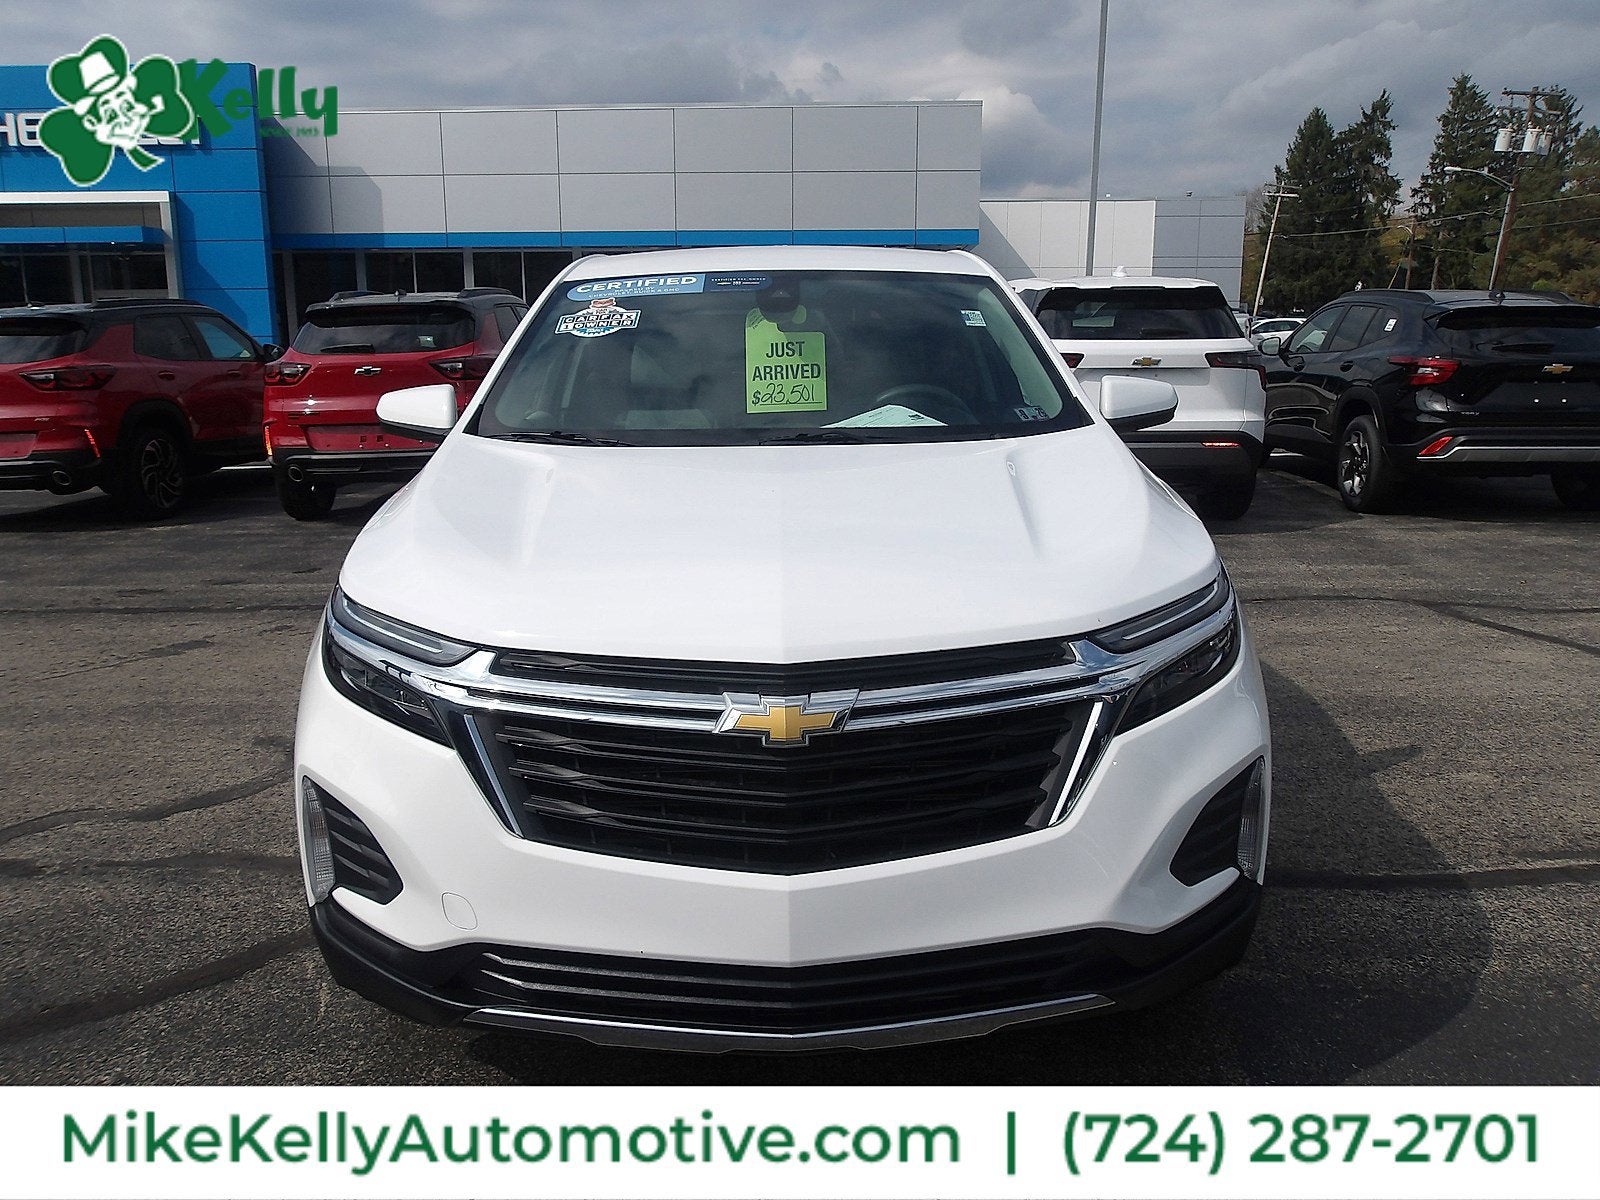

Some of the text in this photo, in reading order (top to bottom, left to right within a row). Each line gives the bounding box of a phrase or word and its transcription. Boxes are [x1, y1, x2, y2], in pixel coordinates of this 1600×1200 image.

[576, 276, 697, 293] CERTIFIED
[564, 313, 634, 323] CARFAX
[574, 320, 633, 329] OWNER
[765, 340, 805, 358] JUST
[752, 363, 821, 381] ARRIVED
